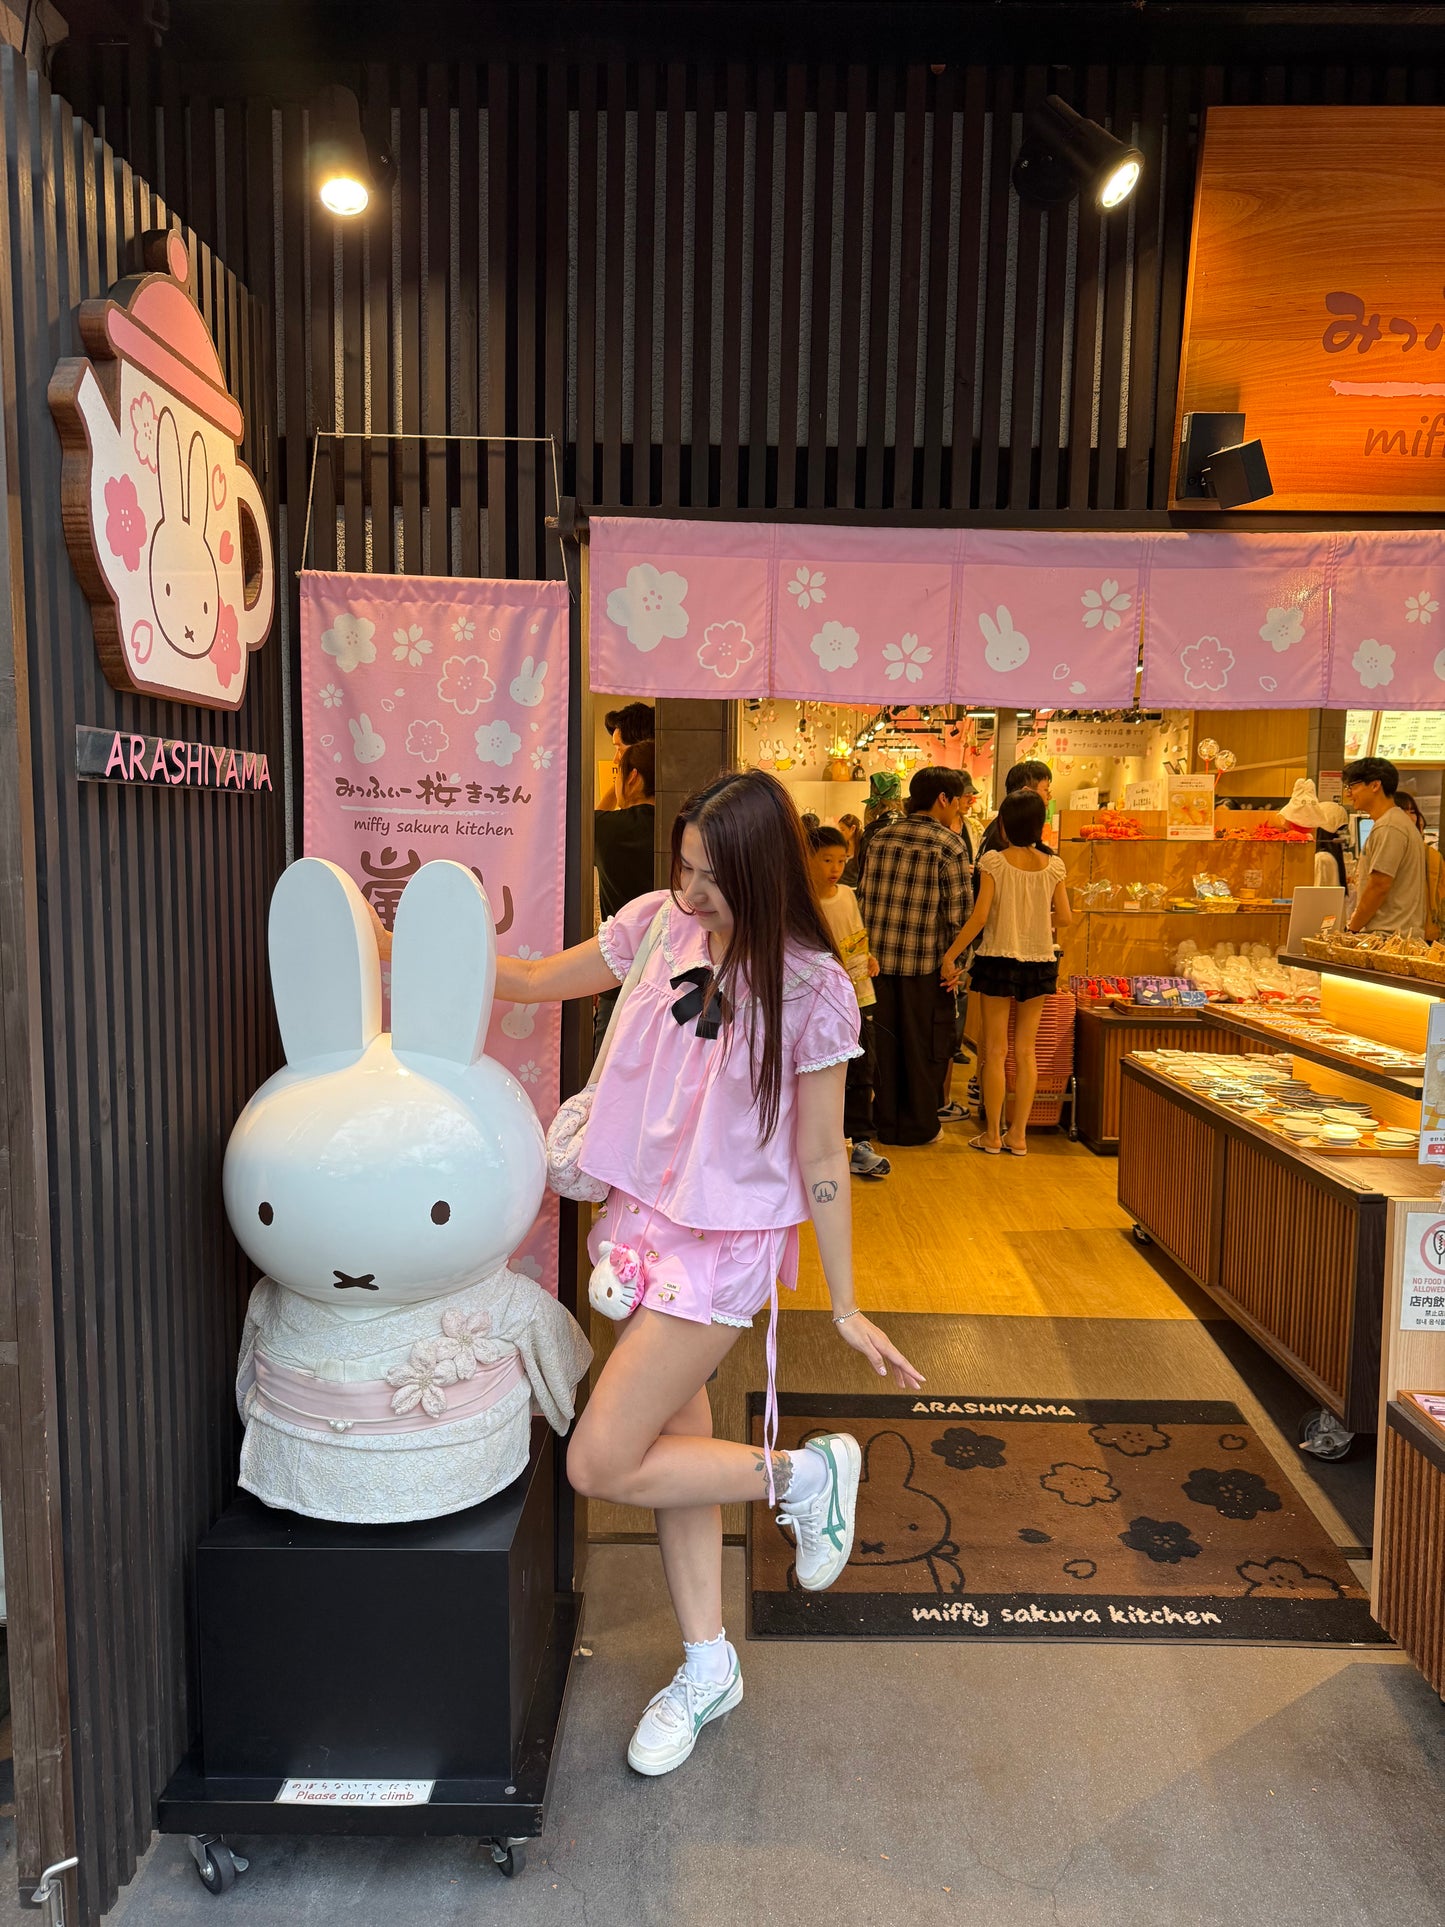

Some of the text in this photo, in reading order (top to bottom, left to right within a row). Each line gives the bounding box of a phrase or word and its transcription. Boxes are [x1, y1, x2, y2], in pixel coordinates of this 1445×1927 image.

[1364, 413, 1445, 458] mif
[105, 731, 273, 792] ARASHIYAMA
[354, 816, 514, 836] miffy sakura kitchen
[1412, 1277, 1423, 1285] NO
[912, 1401, 1076, 1417] ARASHIYAMA
[911, 1602, 1222, 1627] miffy sakura kitchen
[295, 1790, 414, 1801] Please don't climb
